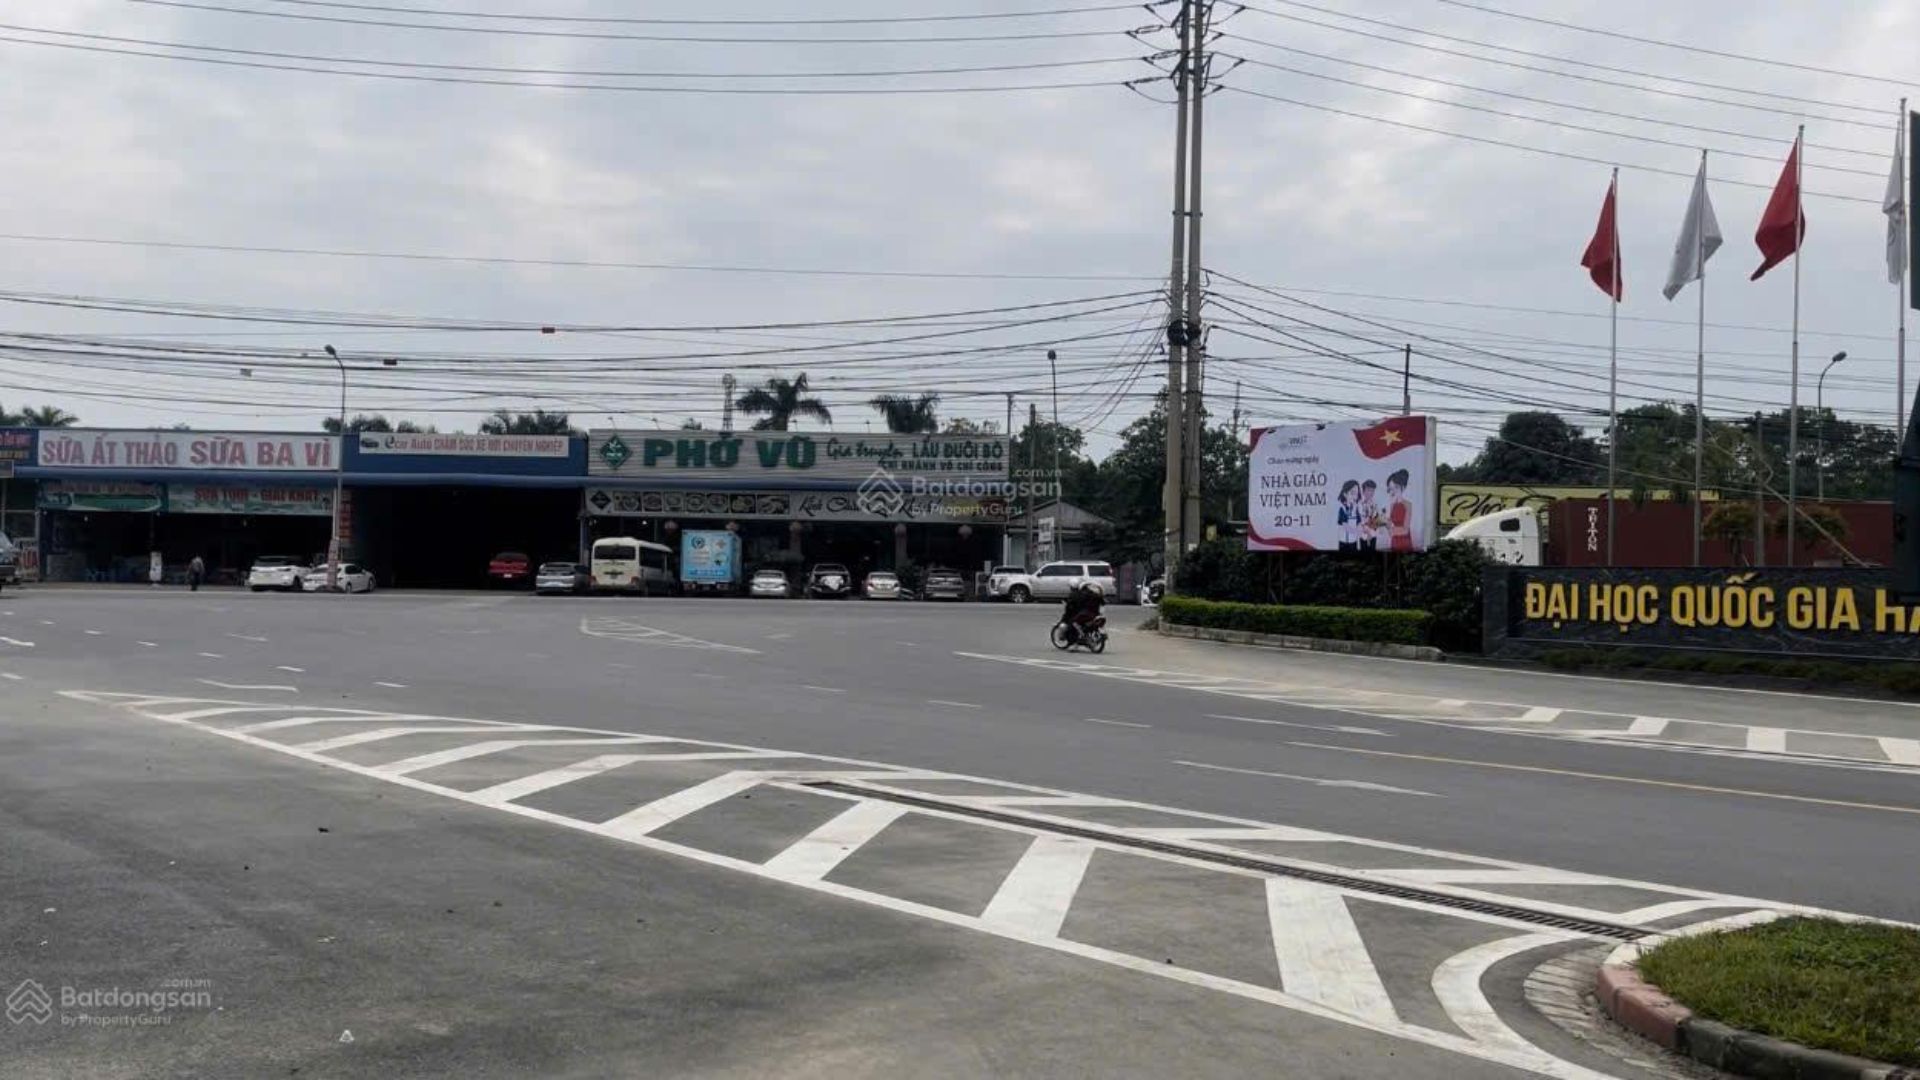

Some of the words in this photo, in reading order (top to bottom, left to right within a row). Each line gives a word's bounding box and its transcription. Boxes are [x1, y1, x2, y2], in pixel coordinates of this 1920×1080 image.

[42, 434, 85, 464] SỮA
[124, 433, 178, 466] THẢO
[190, 436, 247, 466] SỮA
[257, 442, 295, 467] BA
[304, 438, 330, 467] VÌ
[644, 433, 742, 468] PHỞ
[1261, 472, 1290, 488] NHÀ
[1293, 471, 1327, 487] GIÁO
[1260, 491, 1290, 509] VIỆT
[1294, 493, 1327, 506] NAM
[1274, 515, 1310, 527] 20-11
[1587, 507, 1599, 551] TRITON
[1525, 582, 1579, 629] ĐẠI
[1588, 582, 1659, 633] HỌC
[1671, 573, 1776, 628] QUỐC
[1787, 586, 1861, 631] GIA
